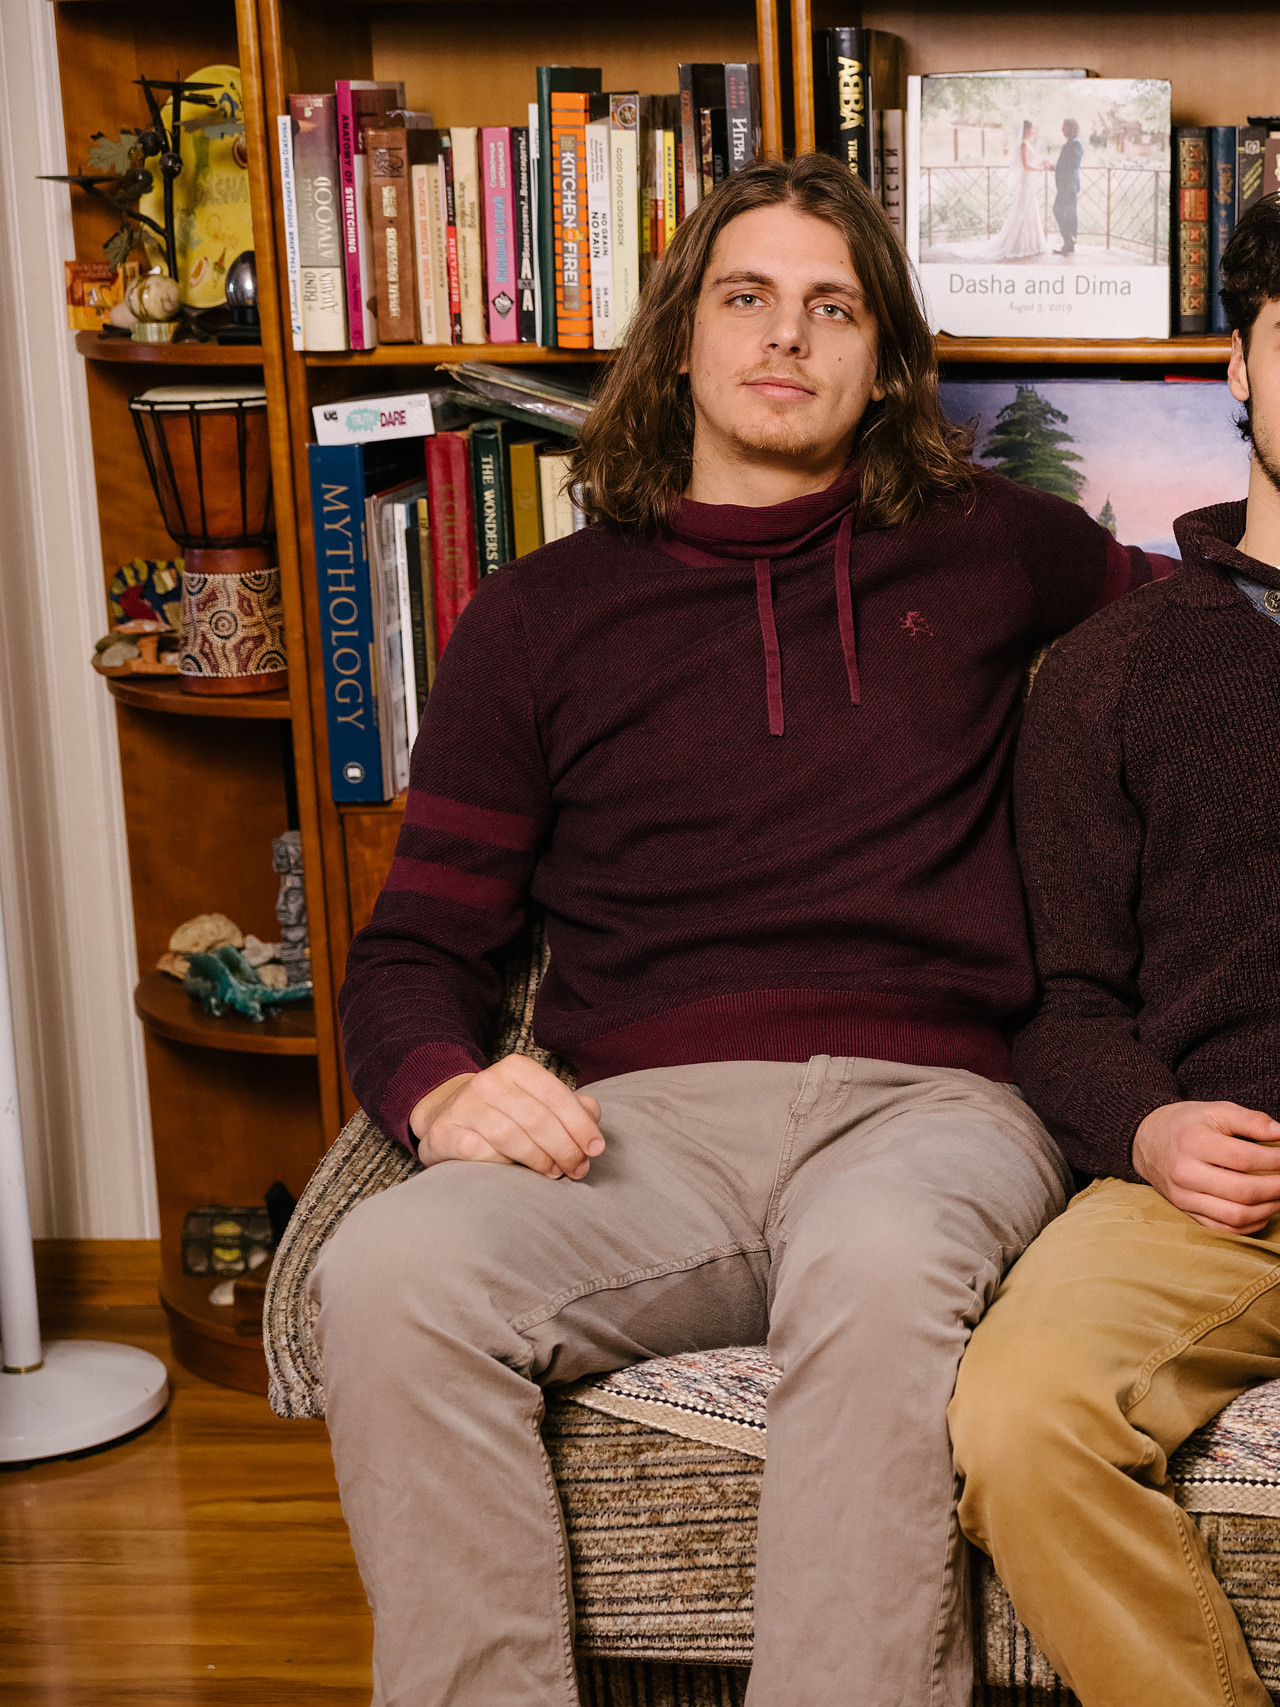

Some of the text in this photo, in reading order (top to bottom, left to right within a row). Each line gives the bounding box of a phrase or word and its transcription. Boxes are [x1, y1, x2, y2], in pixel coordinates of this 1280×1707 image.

[837, 55, 866, 131] ABBA
[731, 116, 748, 161] Игры
[847, 137, 859, 162] THE
[341, 114, 357, 254] ANATOMY OF STRETCHING
[561, 151, 578, 229] KITCHEN
[616, 174, 624, 198] FOOD
[313, 176, 335, 260] ATWOOD
[591, 211, 600, 259] NO PAIN
[601, 212, 609, 226] NO
[616, 199, 625, 247] COOKBOOK
[449, 237, 460, 302] ИЕРУСАЛИМ
[563, 242, 579, 287] FIRE!
[949, 273, 1132, 296] Dasha and Dima
[1007, 302, 1034, 314] August
[1048, 303, 1073, 313] 2019
[379, 409, 407, 428] DARE
[481, 453, 495, 485] THE
[483, 488, 500, 561] WONDERS
[320, 481, 366, 731] MYTHOLOGY
